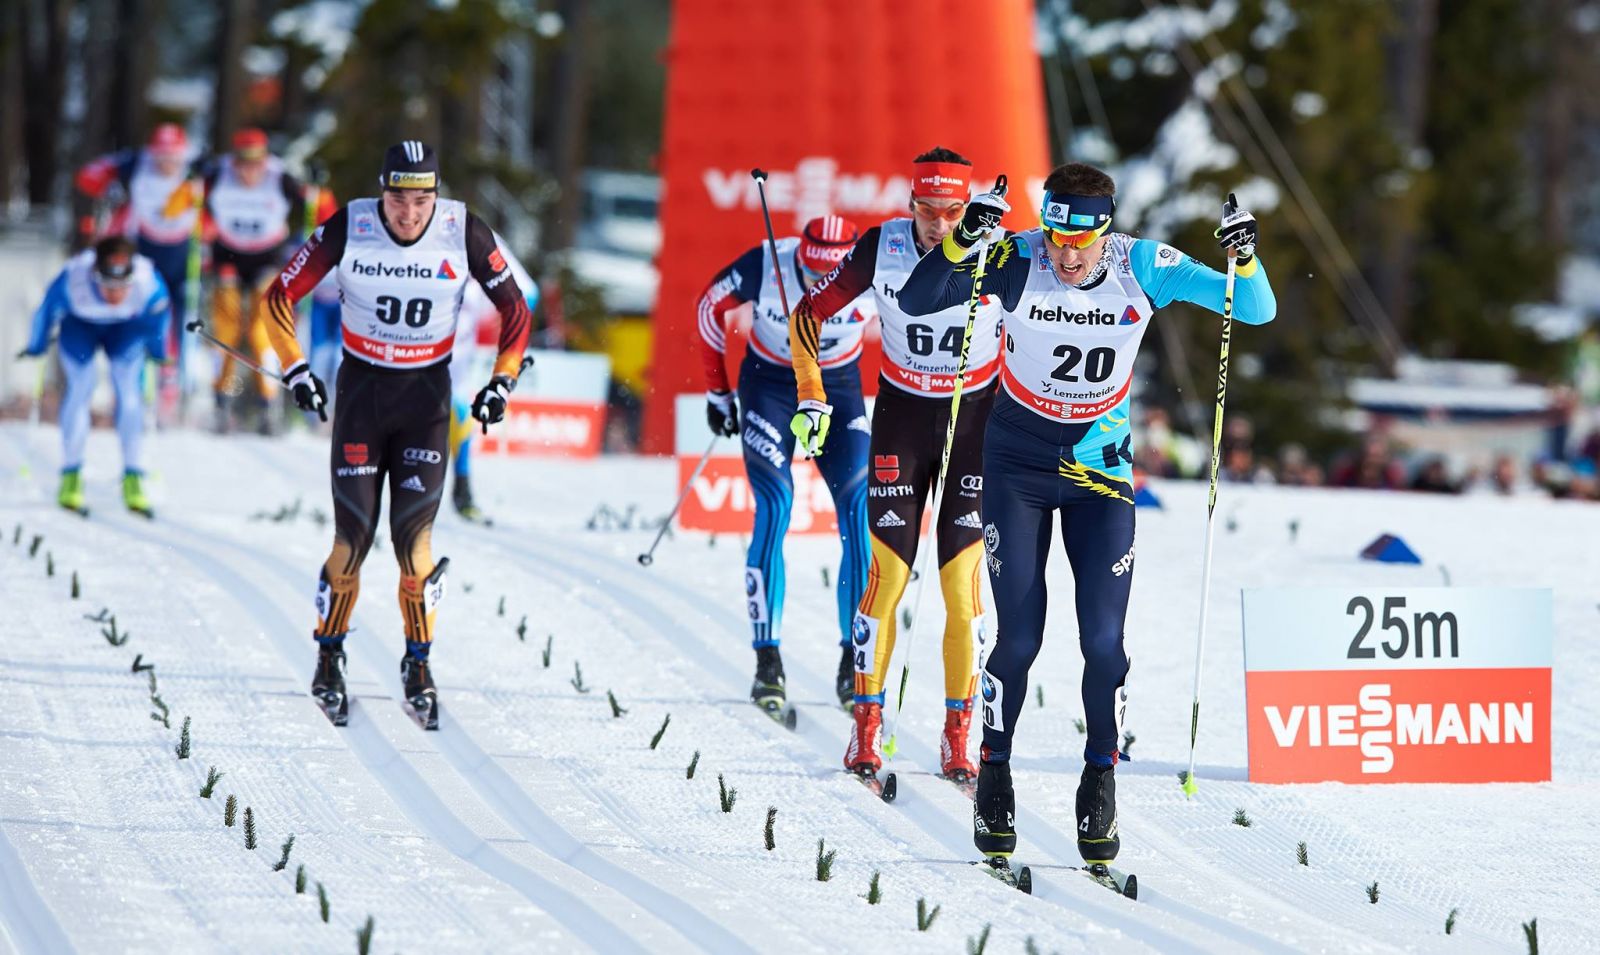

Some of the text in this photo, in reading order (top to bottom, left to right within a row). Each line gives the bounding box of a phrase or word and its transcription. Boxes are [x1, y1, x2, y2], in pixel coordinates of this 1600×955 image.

[921, 174, 964, 188] VIESSMANN
[704, 157, 993, 234] VIESSMA
[806, 244, 851, 262] LUKO
[352, 259, 433, 279] helvetia
[376, 294, 433, 328] 38
[1028, 304, 1116, 326] helvetia
[362, 340, 435, 363] VIESSMANN
[906, 323, 966, 358] 64
[1050, 344, 1116, 383] 20
[899, 369, 973, 392] VIESSMAN
[1054, 385, 1116, 400] Lenzerheide
[1032, 397, 1118, 419] VIESSMANN
[744, 426, 786, 469] LUKOIL
[1346, 596, 1459, 660] 25m
[1263, 683, 1534, 774] VIESSMANN
